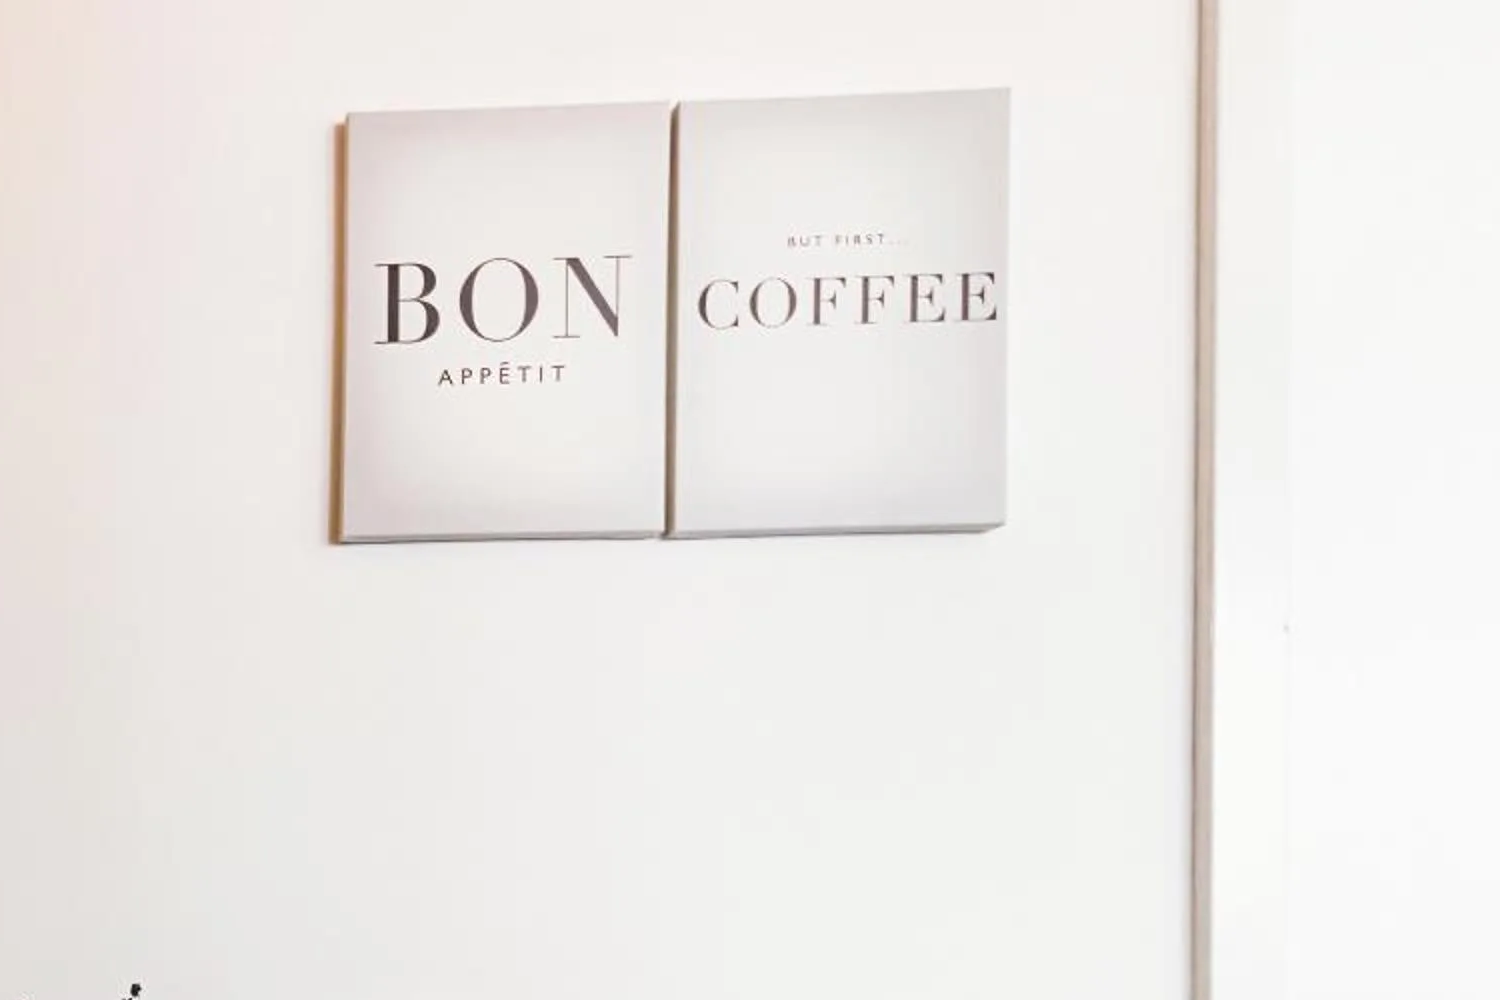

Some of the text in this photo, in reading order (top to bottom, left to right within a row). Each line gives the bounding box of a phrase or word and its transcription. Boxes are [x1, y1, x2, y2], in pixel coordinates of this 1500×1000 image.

[787, 234, 822, 247] BUT
[374, 254, 633, 345] BON
[697, 271, 997, 330] COFFEE
[437, 361, 566, 386] APPÉTIT
